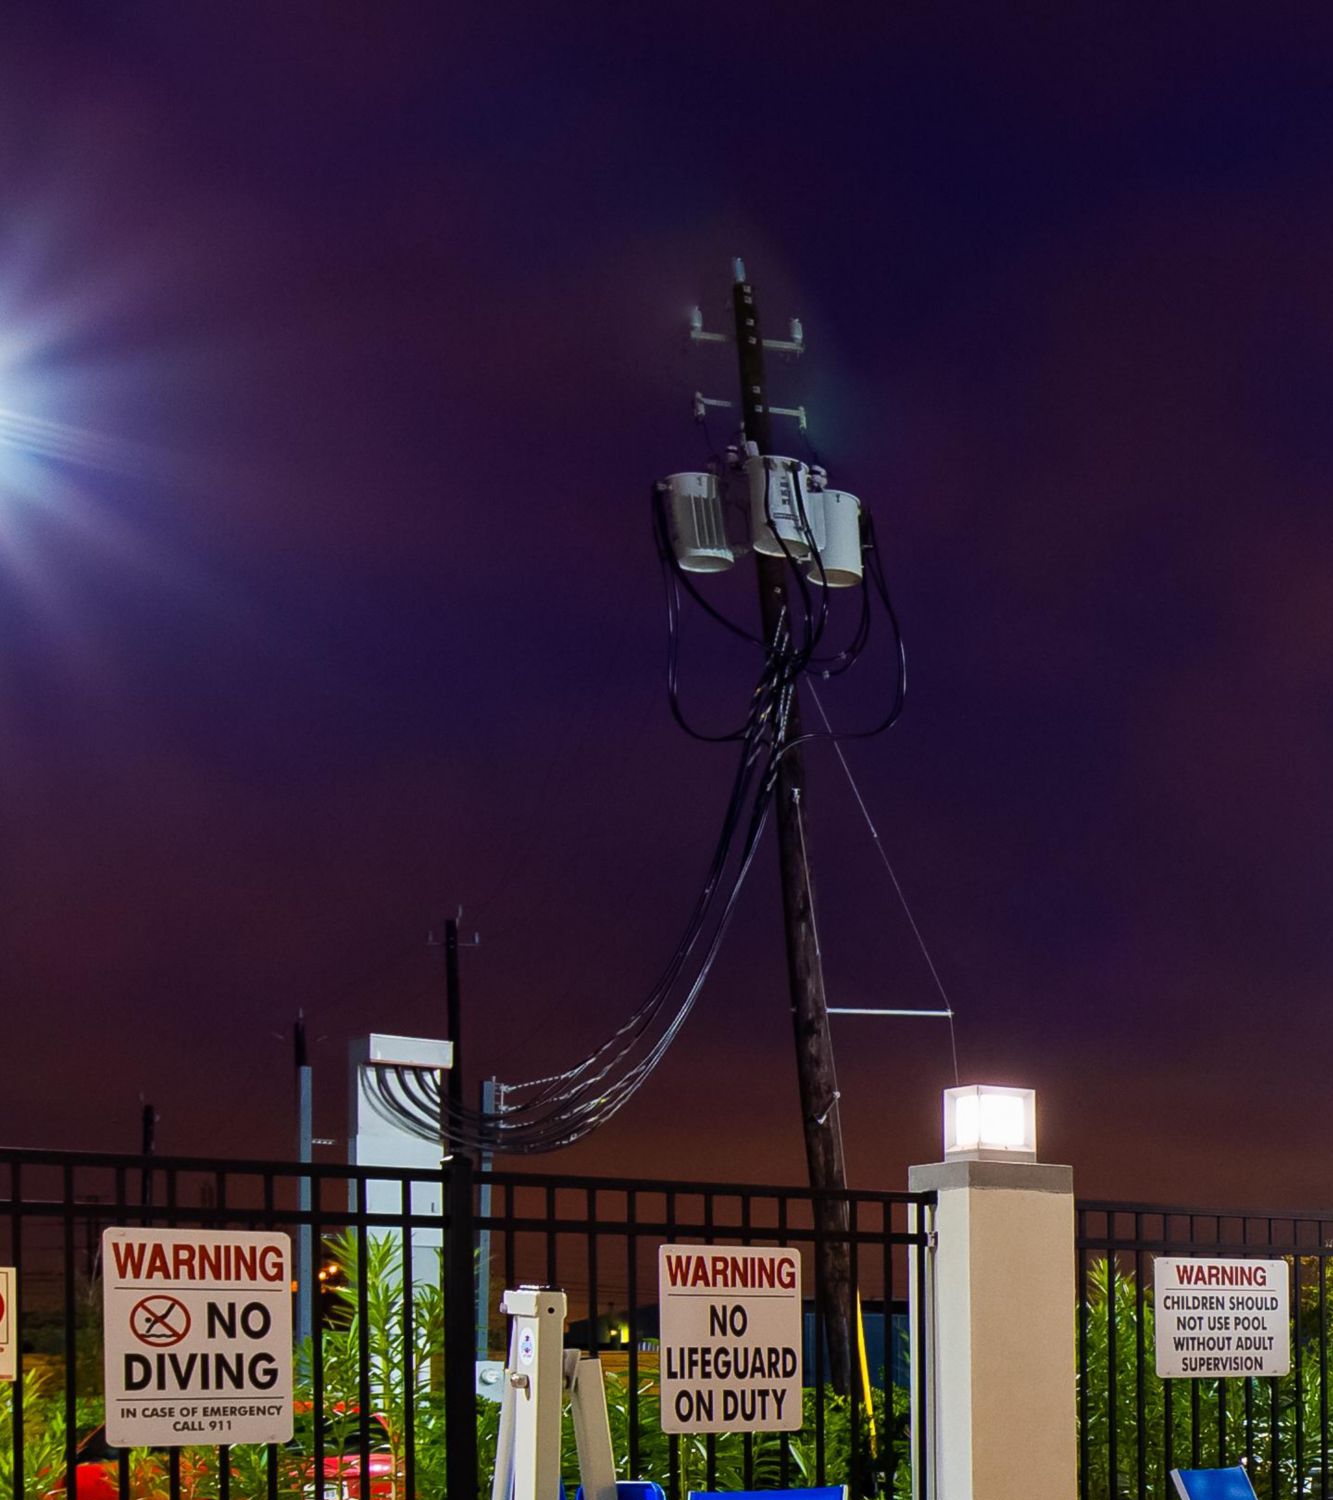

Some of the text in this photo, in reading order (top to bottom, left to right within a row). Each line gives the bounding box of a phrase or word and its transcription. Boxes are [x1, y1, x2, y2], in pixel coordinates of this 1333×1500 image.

[112, 1242, 284, 1282] WARNING
[666, 1255, 796, 1289] WARNING
[1176, 1265, 1267, 1286] WARNING
[1163, 1295, 1278, 1311] CHILDREN SHOULD
[207, 1301, 271, 1339] NO
[710, 1304, 747, 1337] NO
[1176, 1316, 1267, 1331] NOT USE POOL
[1173, 1336, 1274, 1351] WITHOUT ADULT
[124, 1352, 279, 1391] DIVING
[666, 1347, 797, 1379] LIFEGUARD
[1182, 1356, 1263, 1372] SUPERVISION
[121, 1405, 283, 1418] IN CASE OF EMERGENCY
[675, 1389, 787, 1423] ON DUTY
[173, 1420, 232, 1432] CALL 911
